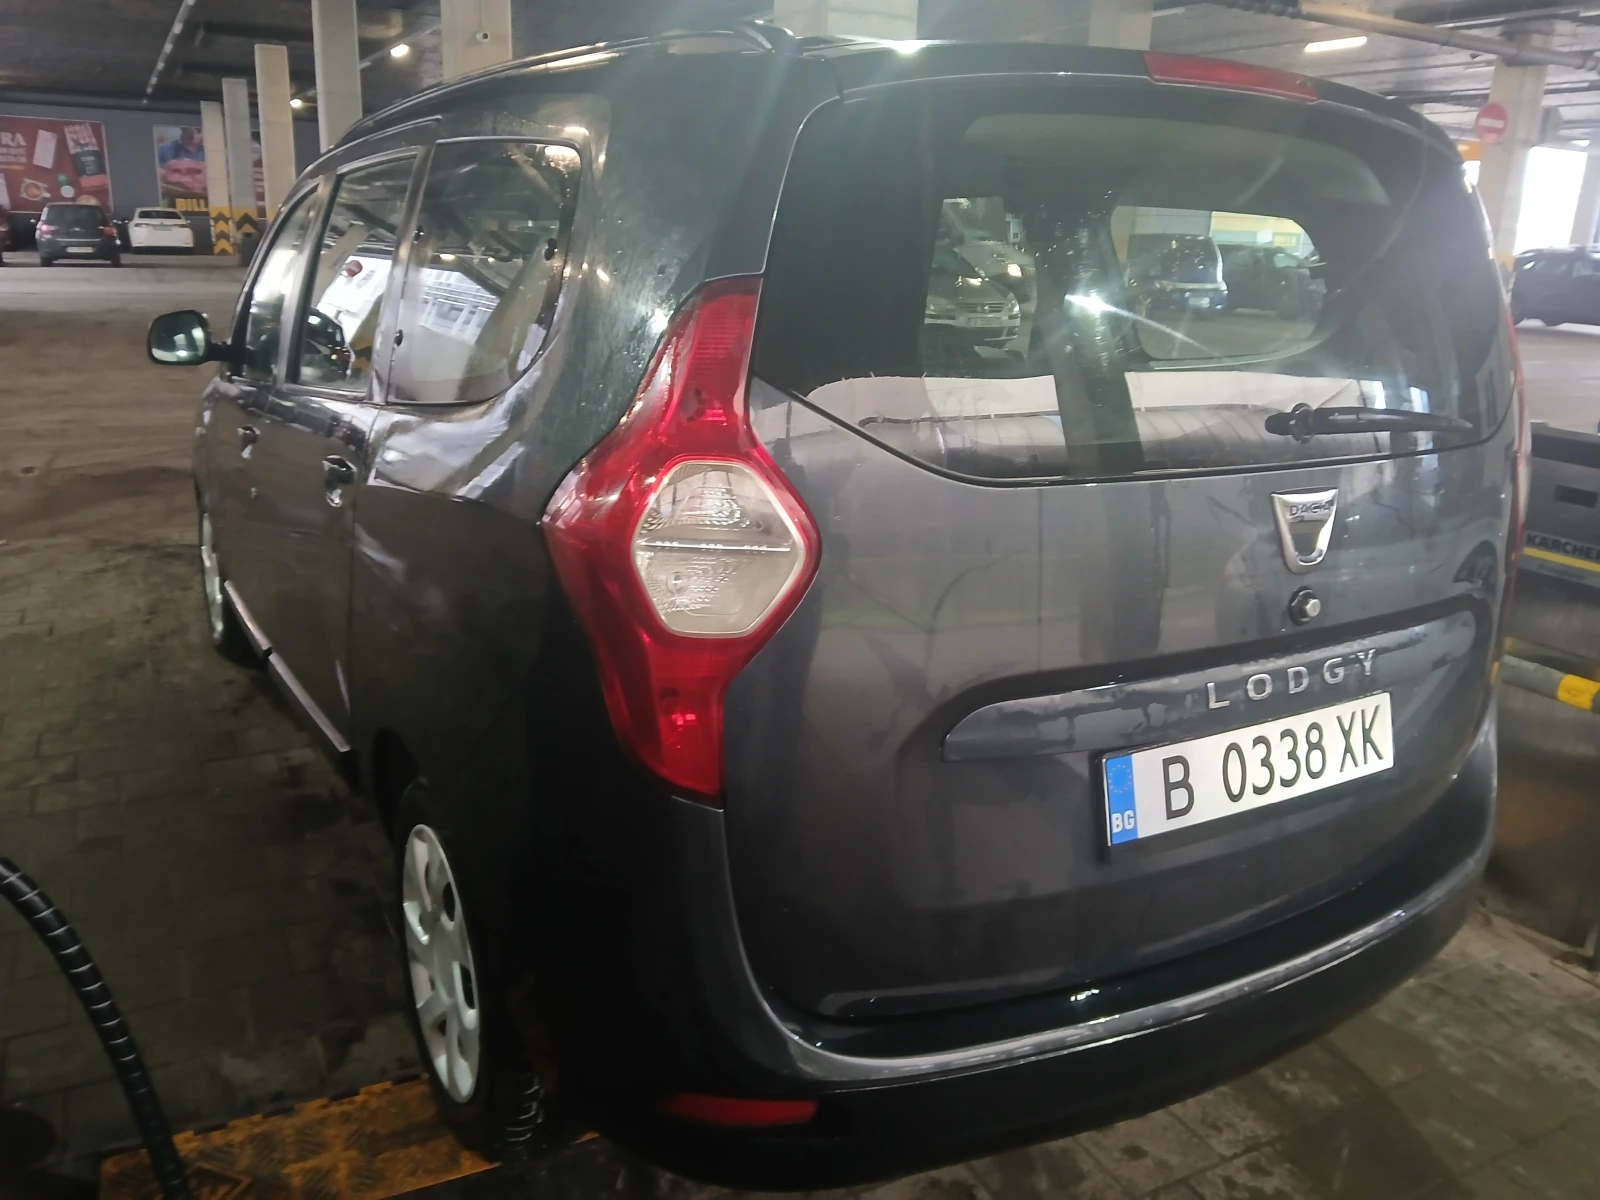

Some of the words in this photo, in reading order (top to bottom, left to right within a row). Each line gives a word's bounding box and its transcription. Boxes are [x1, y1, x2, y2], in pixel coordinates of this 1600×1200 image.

[1206, 648, 1376, 709] LODGY
[1162, 754, 1195, 821] B
[1222, 721, 1327, 803] 0338
[1336, 704, 1384, 773] XK
[1111, 809, 1135, 834] BG
